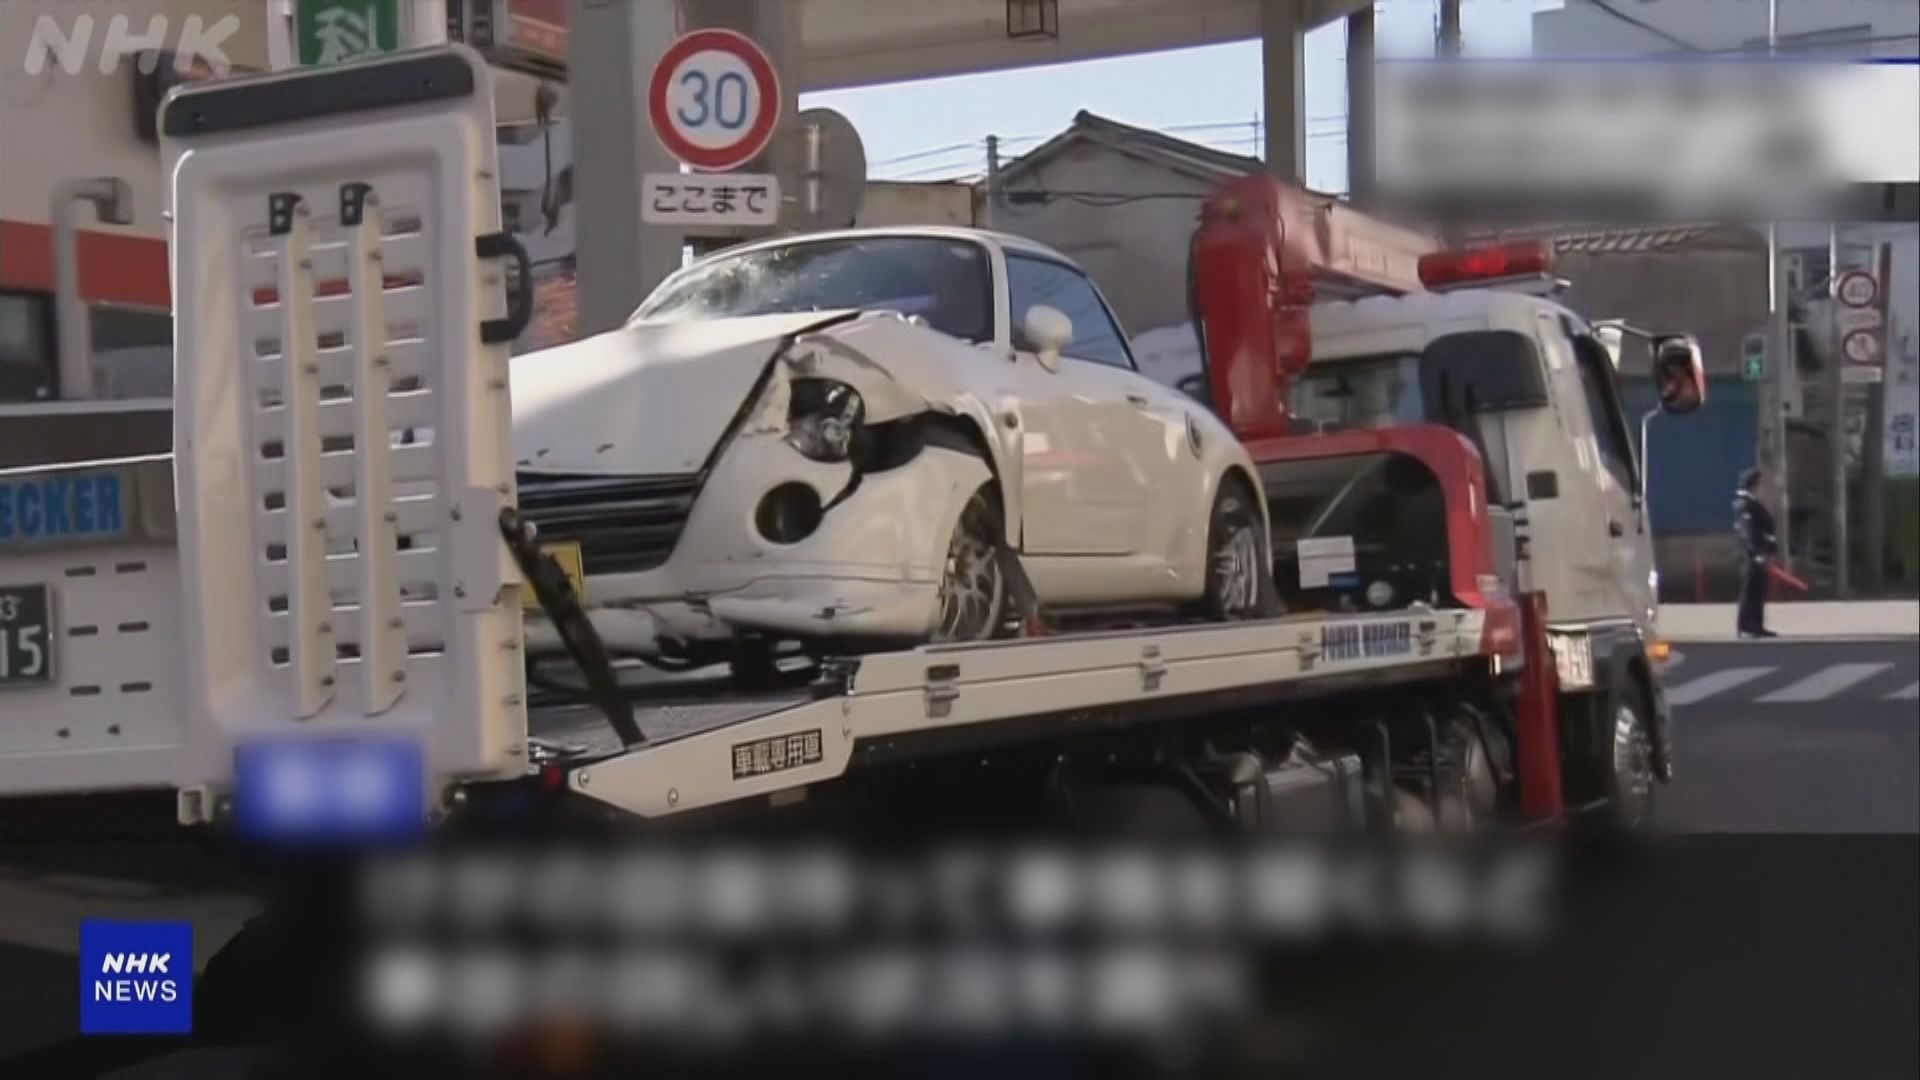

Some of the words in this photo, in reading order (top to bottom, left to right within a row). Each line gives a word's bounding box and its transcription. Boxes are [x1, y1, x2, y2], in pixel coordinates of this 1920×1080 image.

[677, 69, 749, 130] 30
[653, 184, 768, 214] ここまで
